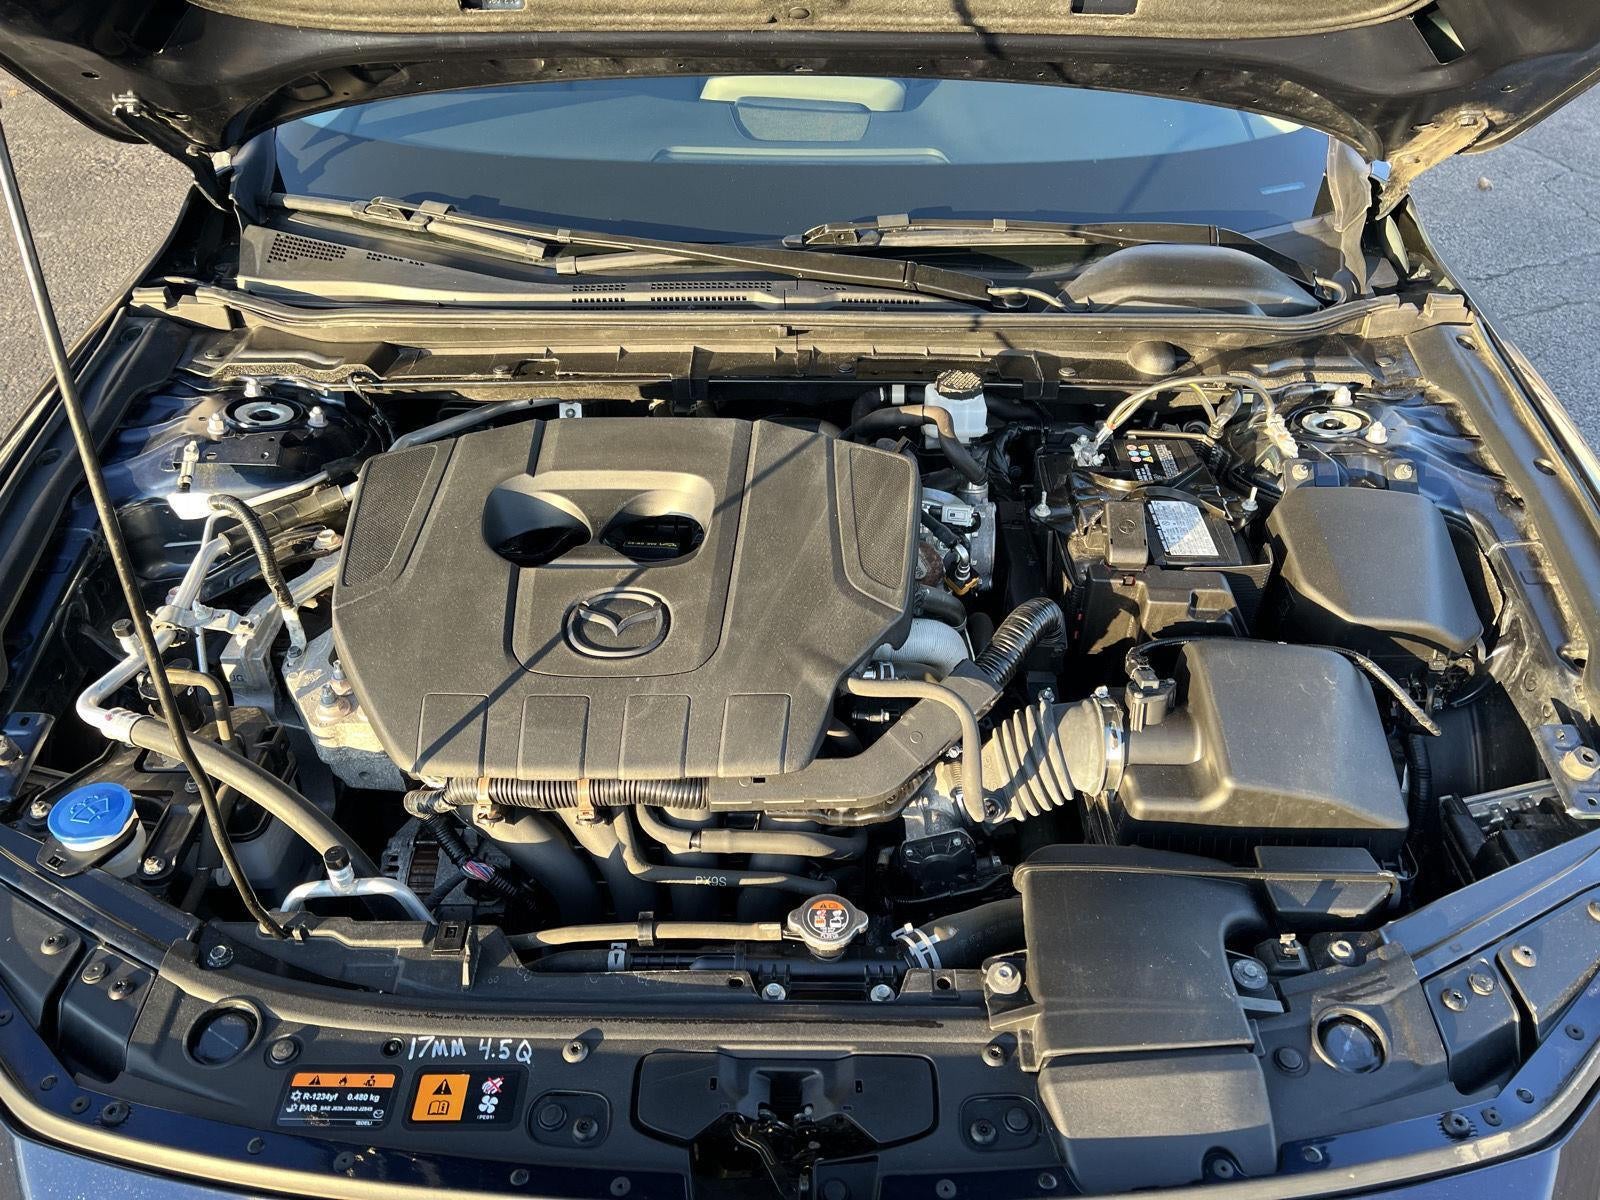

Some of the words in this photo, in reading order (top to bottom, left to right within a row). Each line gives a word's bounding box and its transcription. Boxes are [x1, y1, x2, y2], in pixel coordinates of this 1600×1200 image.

[695, 875, 727, 887] PX9S
[408, 1035, 467, 1061] 17MM
[302, 1092, 339, 1102] R-1234yf
[347, 1092, 368, 1101] 0.480
[369, 1093, 380, 1103] kg
[299, 1104, 318, 1112] PAG
